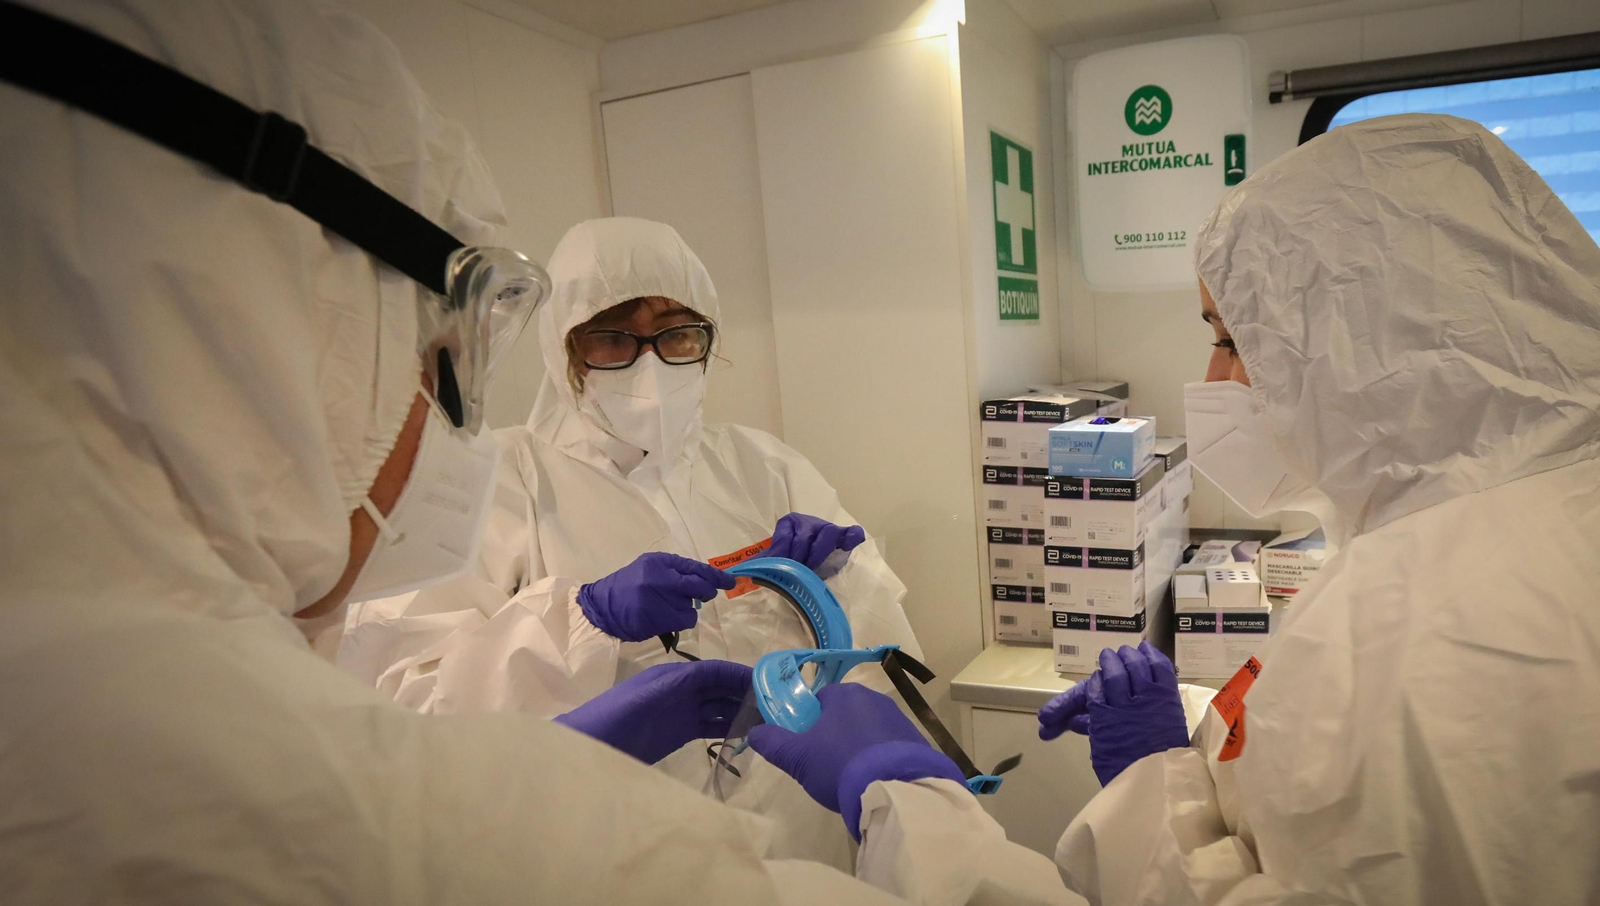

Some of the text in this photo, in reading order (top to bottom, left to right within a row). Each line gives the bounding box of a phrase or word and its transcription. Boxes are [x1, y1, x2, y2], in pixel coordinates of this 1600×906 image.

[1121, 140, 1176, 158] MUTUA
[1087, 152, 1214, 176] INTERCOMARCAL
[1123, 230, 1187, 244] 900 110 112
[1000, 286, 1039, 315] BOTIQUÍN
[713, 554, 743, 567] CoverStar
